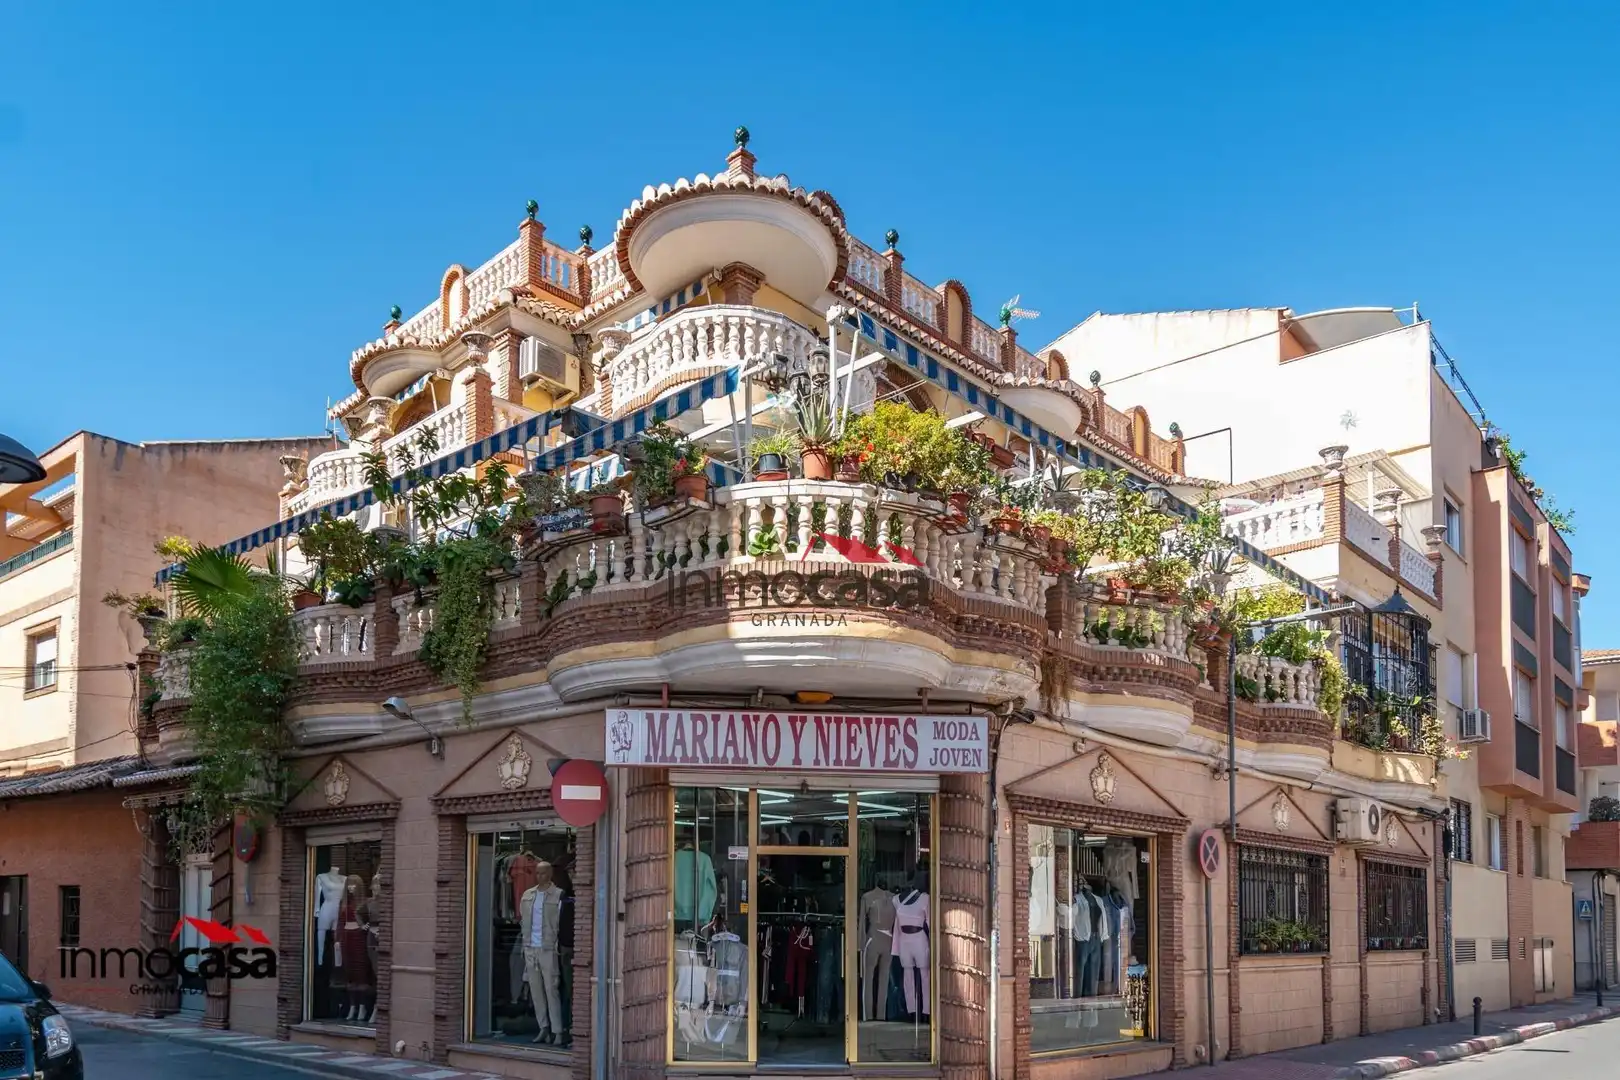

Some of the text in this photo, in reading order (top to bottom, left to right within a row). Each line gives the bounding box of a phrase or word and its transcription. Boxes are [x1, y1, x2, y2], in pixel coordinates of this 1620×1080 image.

[644, 712, 919, 769] MARIANO Y NIEVES
[932, 720, 981, 741] MODA
[929, 748, 982, 767] JOVEN
